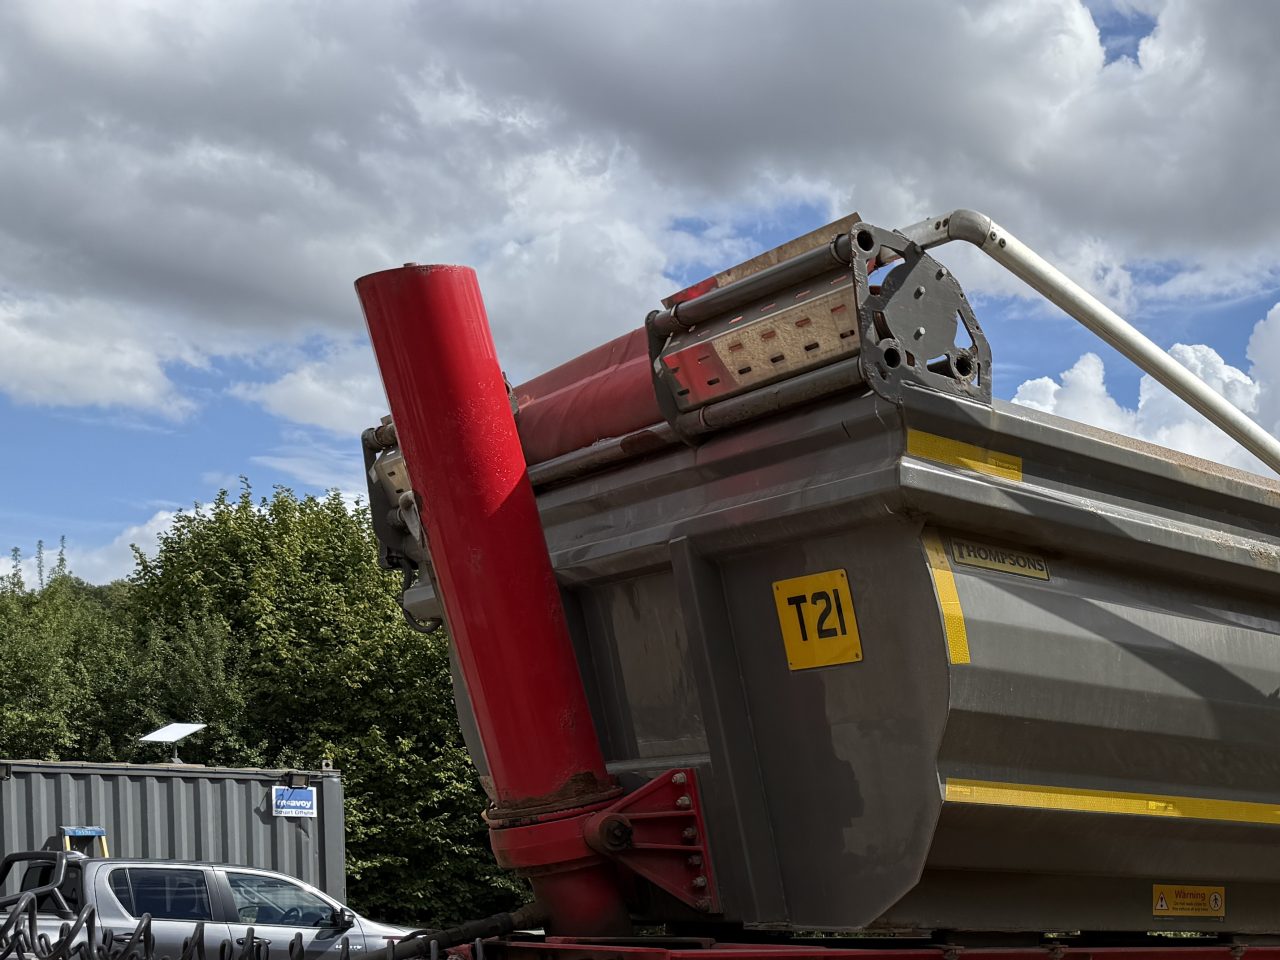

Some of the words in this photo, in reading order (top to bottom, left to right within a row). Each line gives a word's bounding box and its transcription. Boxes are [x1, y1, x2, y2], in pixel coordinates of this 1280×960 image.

[953, 542, 1045, 572] THOMPSONS
[787, 588, 847, 641] T21
[1174, 889, 1206, 901] Warning
